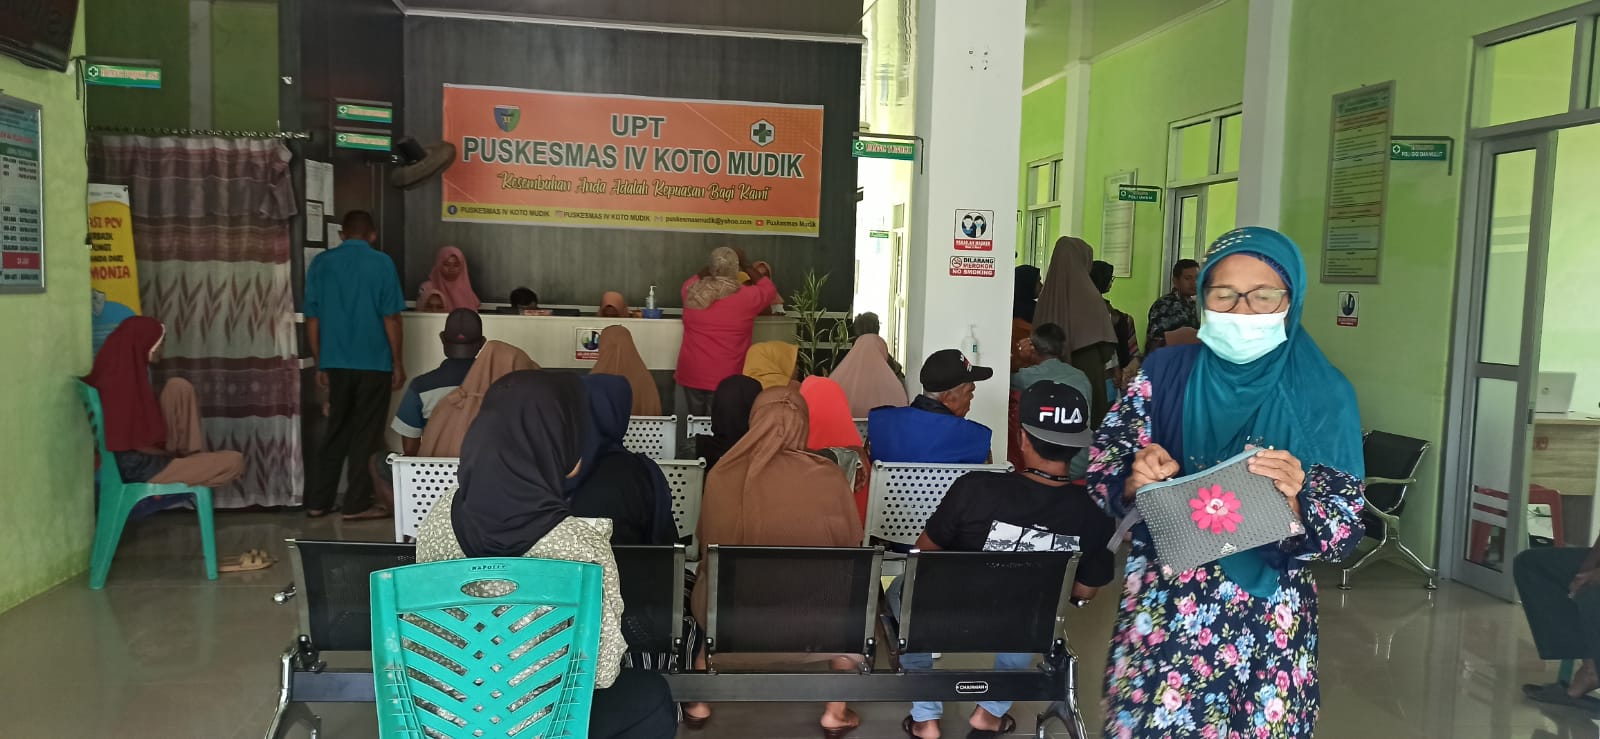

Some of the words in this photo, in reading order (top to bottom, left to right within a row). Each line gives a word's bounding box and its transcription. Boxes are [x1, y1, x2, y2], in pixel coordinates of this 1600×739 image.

[611, 114, 665, 138] UPT
[462, 136, 617, 169] PUSKESMAS
[624, 146, 648, 171] IV
[653, 147, 721, 174] KOTO
[728, 151, 804, 178] MUDIK
[575, 176, 607, 194] Anda
[610, 178, 649, 195] Adalah
[652, 178, 705, 198] Kepuasan
[707, 183, 735, 201] Bagi
[461, 206, 500, 215] PUSKESMAS
[564, 211, 602, 219] PUSKESMAS
[630, 214, 650, 222] MUDIK
[1039, 406, 1083, 424] FILA
